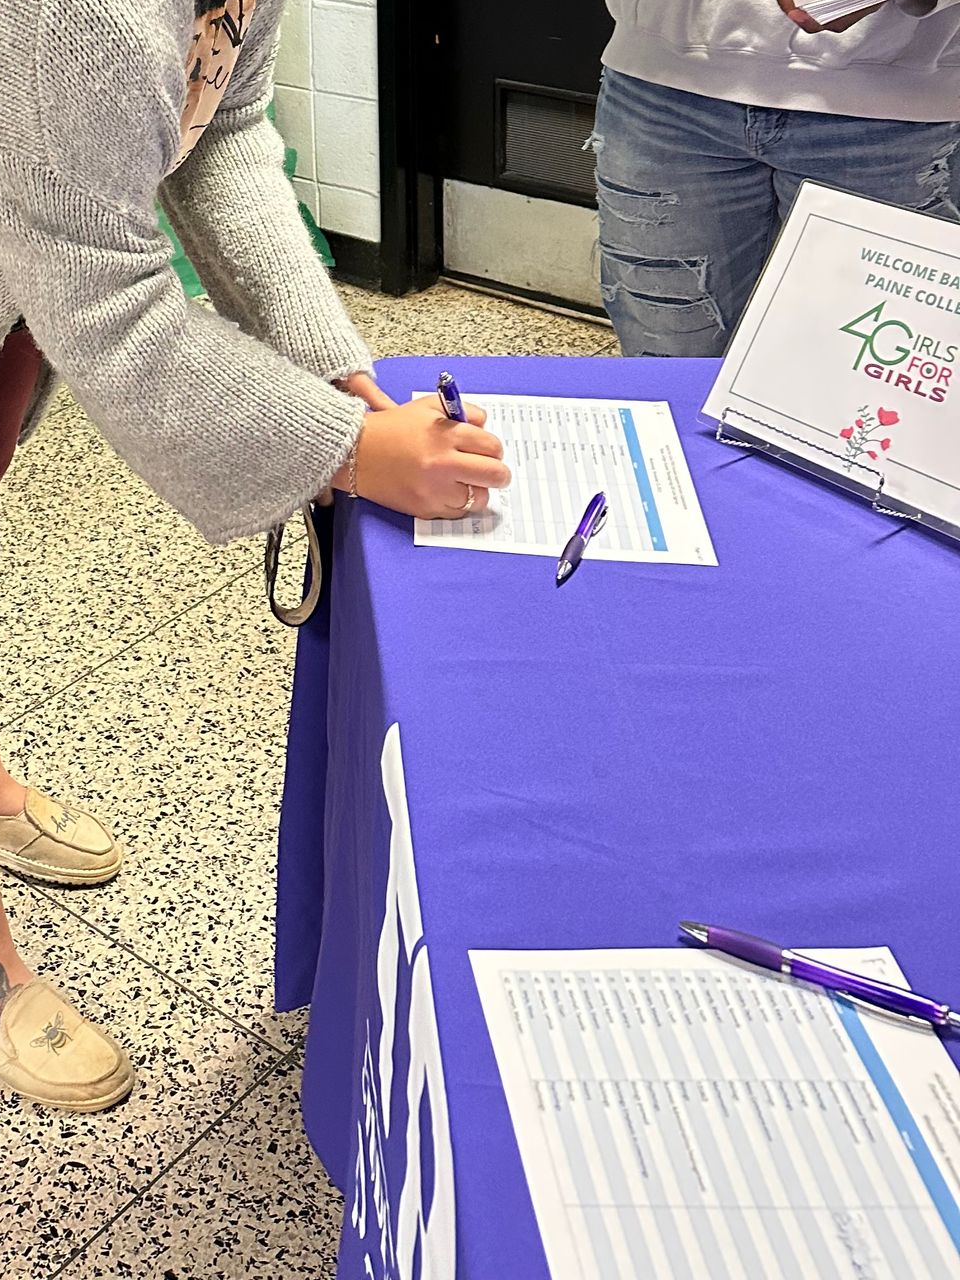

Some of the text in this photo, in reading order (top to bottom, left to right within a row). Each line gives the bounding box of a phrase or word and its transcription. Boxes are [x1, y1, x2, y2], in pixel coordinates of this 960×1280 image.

[860, 247, 960, 291] WELCOME BA
[864, 273, 913, 299] PAINE
[863, 363, 947, 403] GIRLS
[907, 356, 952, 387] FOR
